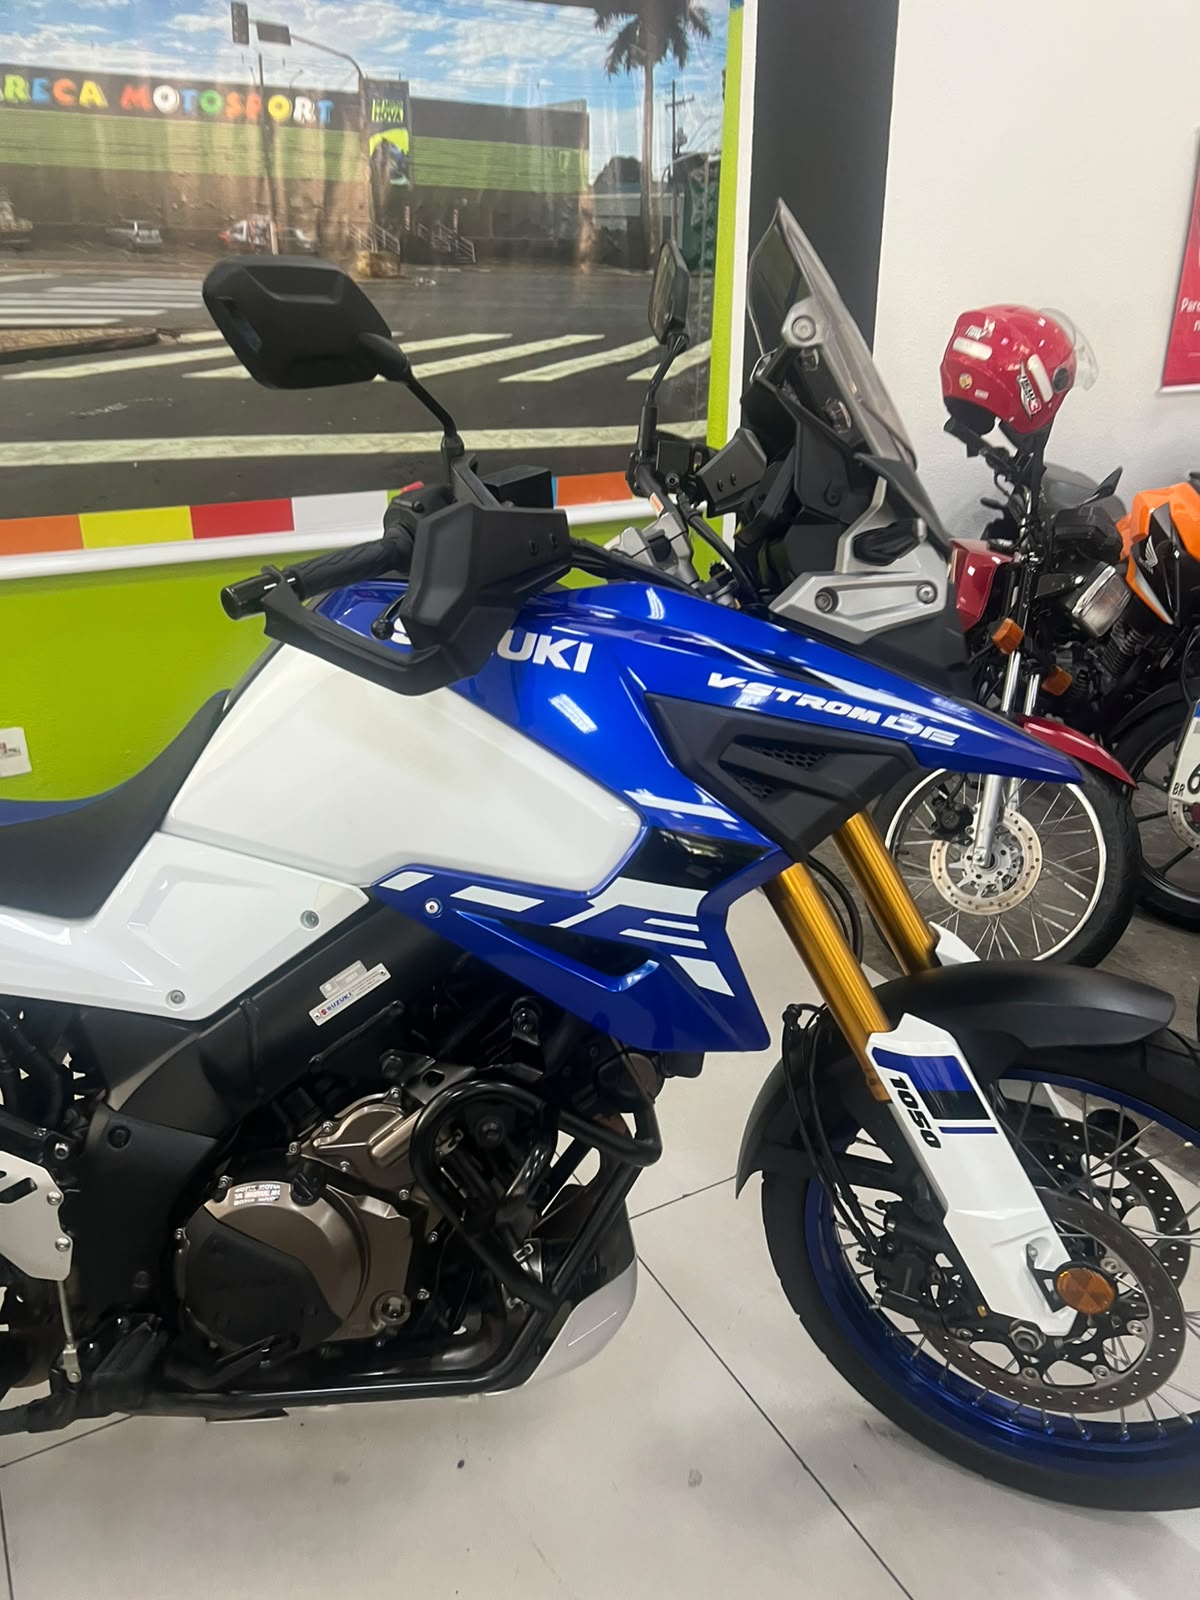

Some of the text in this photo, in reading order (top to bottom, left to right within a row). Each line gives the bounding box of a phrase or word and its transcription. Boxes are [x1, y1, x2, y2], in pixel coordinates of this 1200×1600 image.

[0, 73, 334, 124] RECA MOTOSPORT
[707, 672, 961, 746] V-STROM DE
[1172, 782, 1186, 796] BR
[327, 993, 352, 1010] SUZUKI
[889, 1076, 942, 1148] 1050
